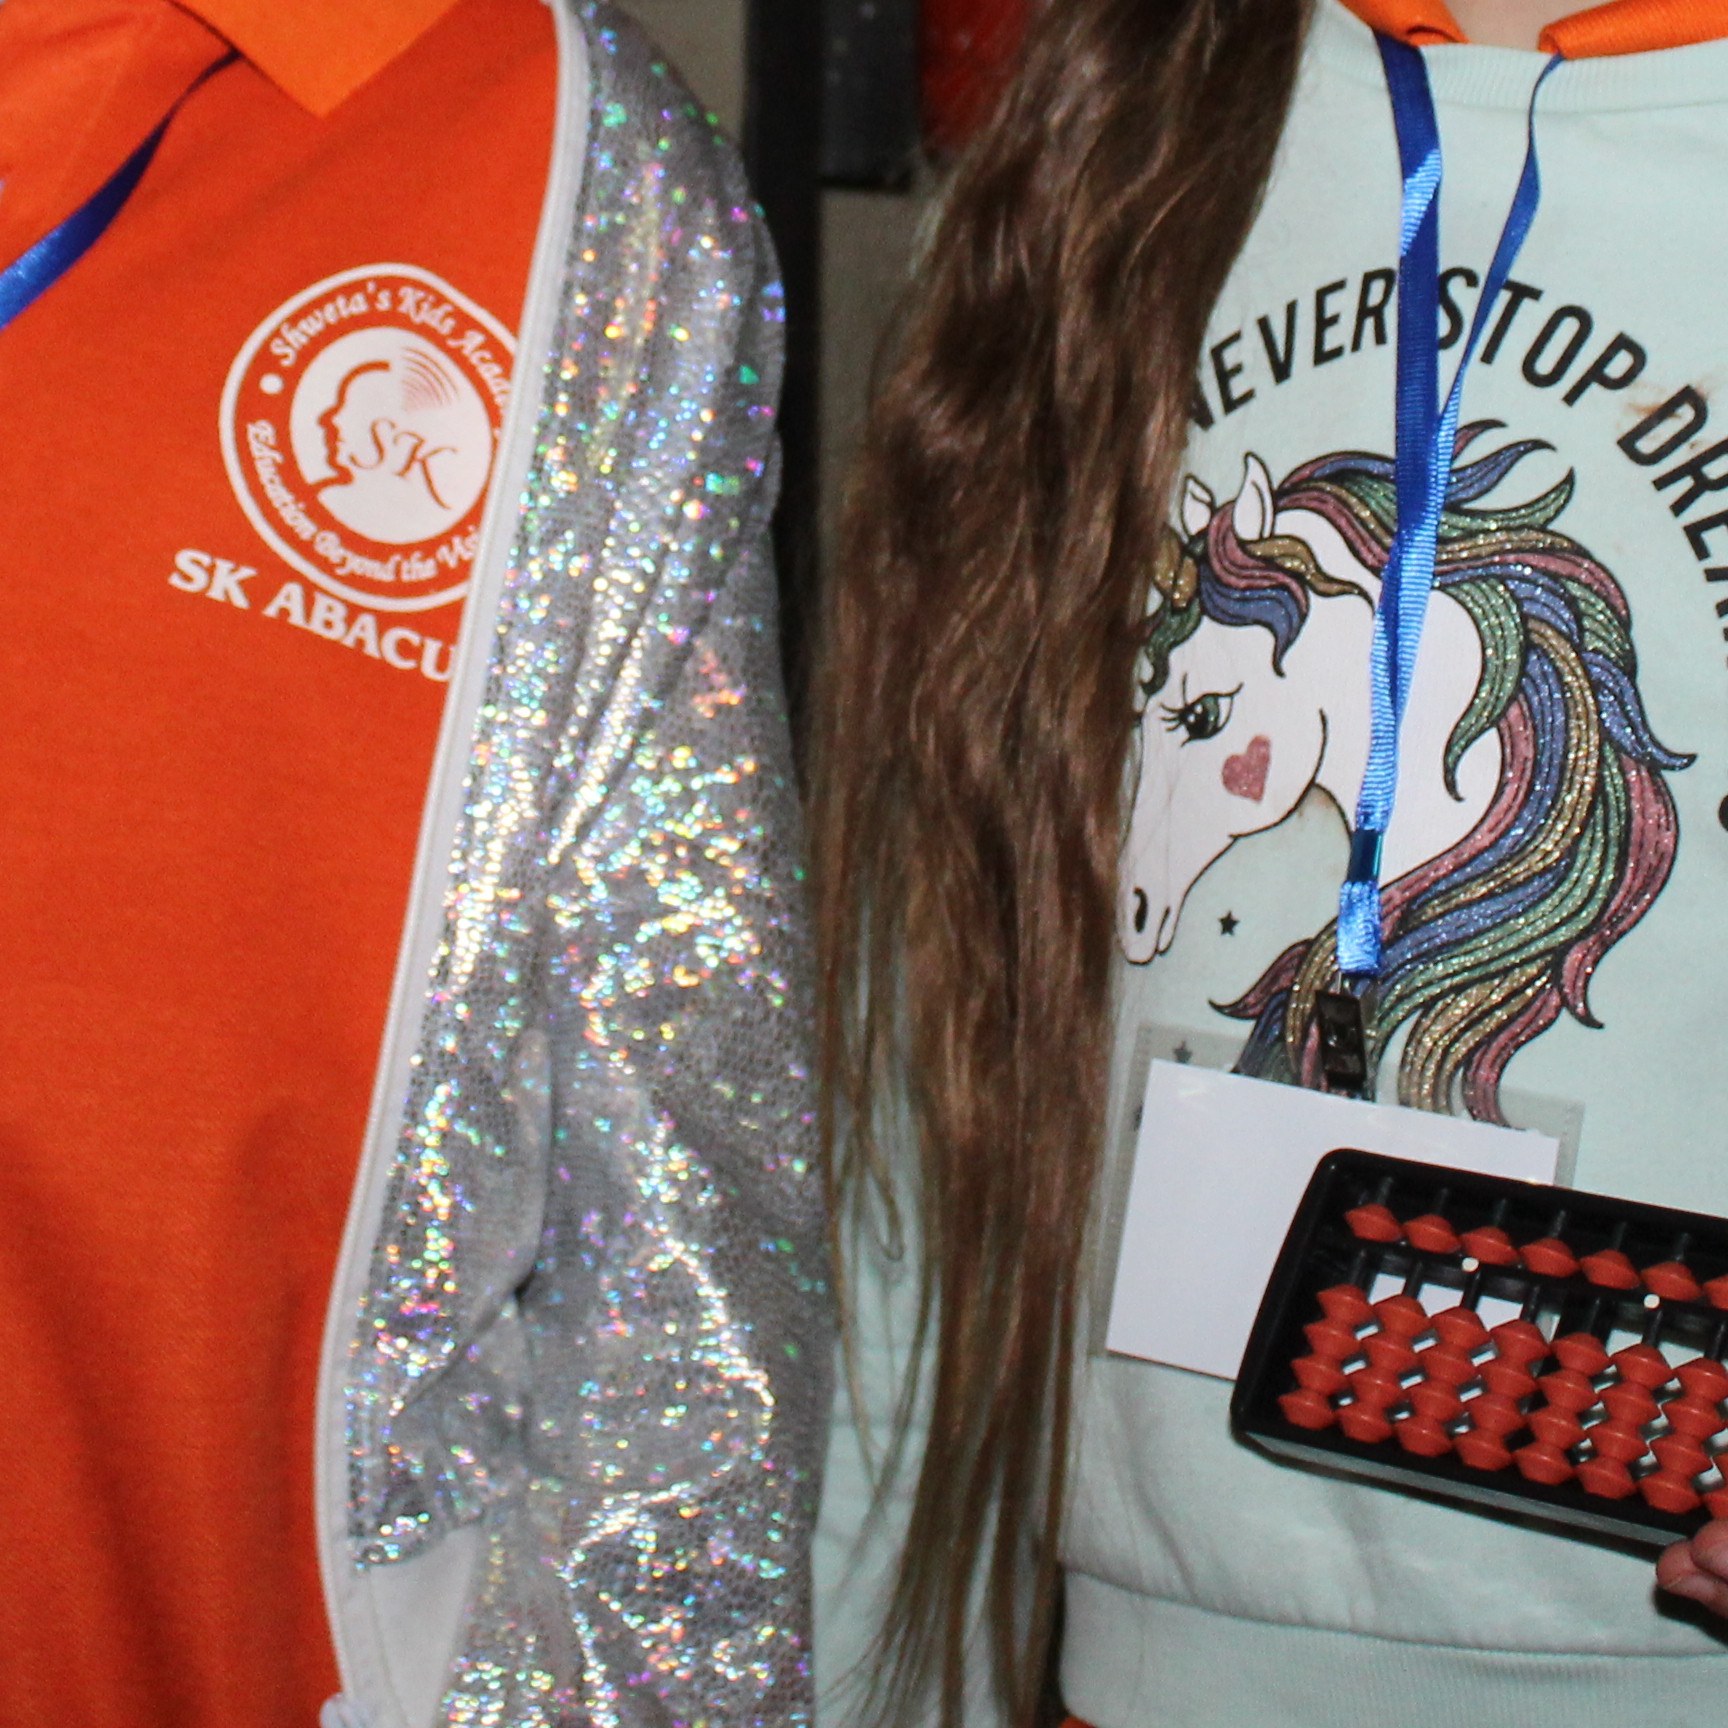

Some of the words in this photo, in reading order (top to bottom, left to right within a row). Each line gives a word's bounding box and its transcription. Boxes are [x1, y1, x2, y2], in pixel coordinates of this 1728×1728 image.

[270, 281, 391, 366] Shweta's
[398, 286, 456, 334] Kids
[1435, 266, 1646, 407] STOP
[247, 419, 319, 541] Education
[401, 550, 438, 582] the
[348, 418, 459, 510] SK
[168, 548, 258, 610] SK
[262, 581, 459, 682] ABACU
